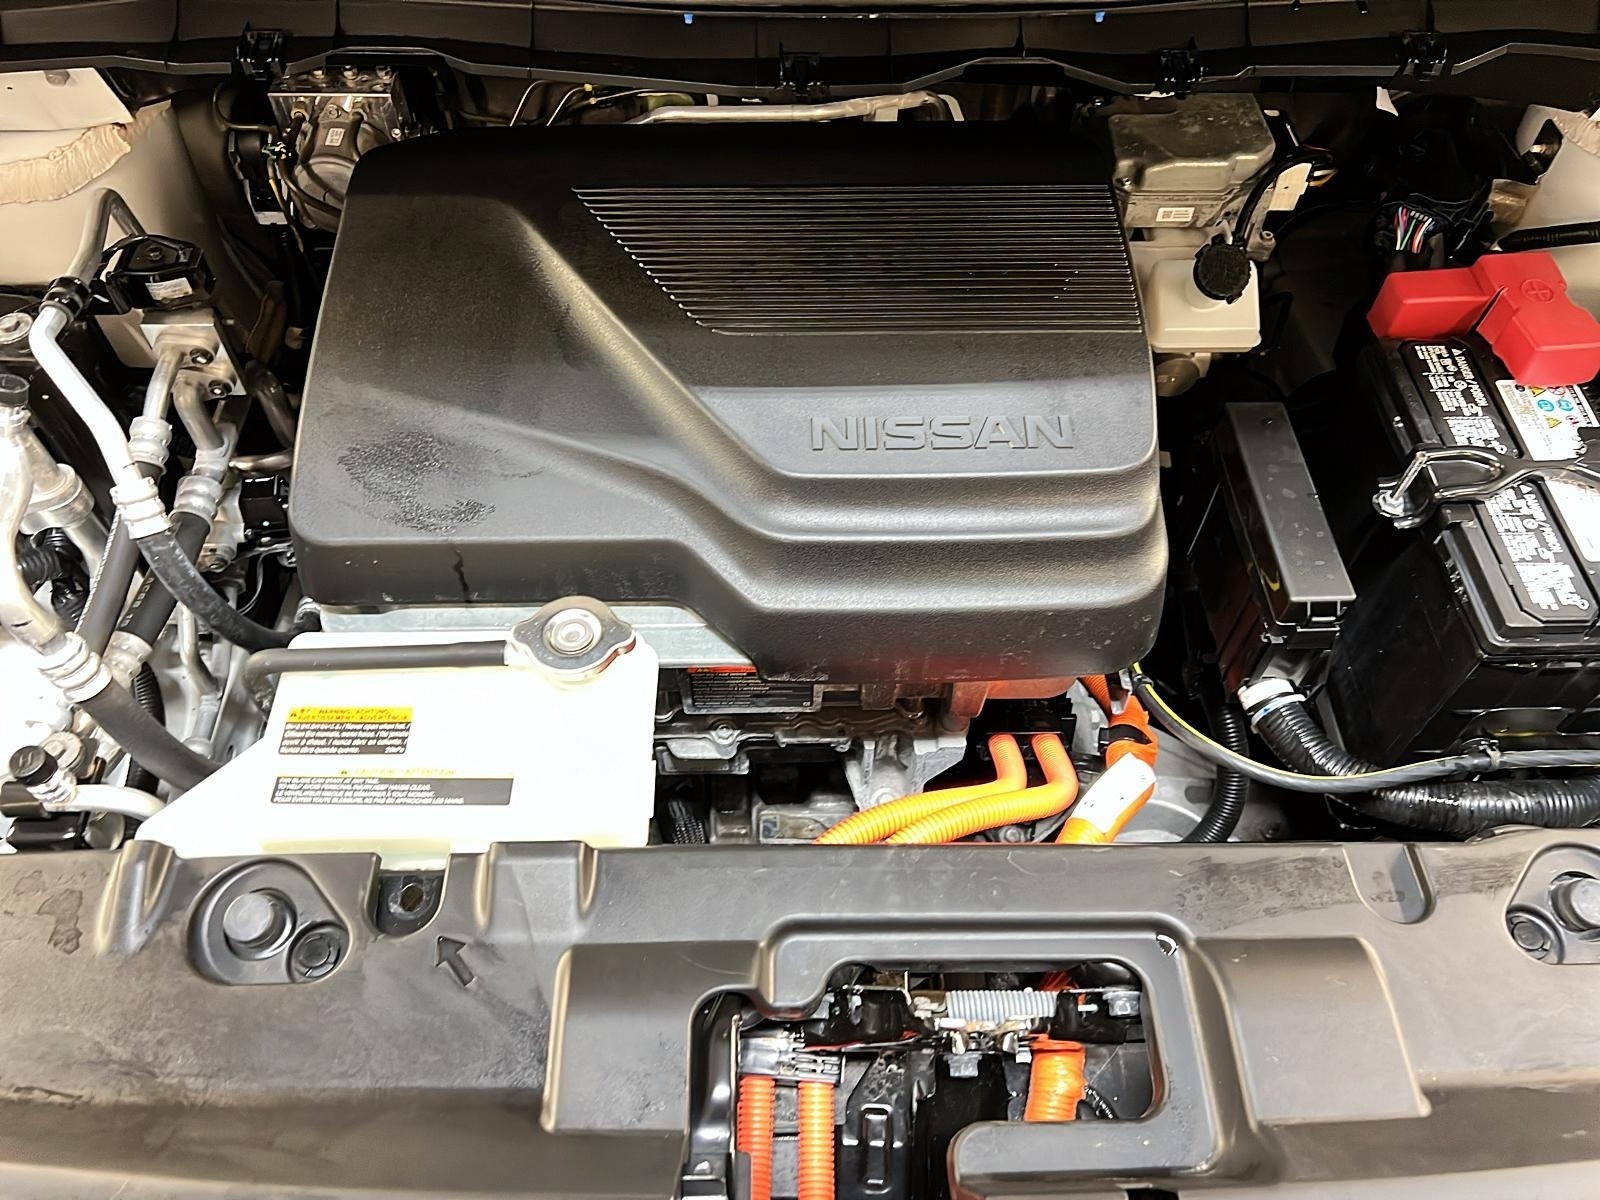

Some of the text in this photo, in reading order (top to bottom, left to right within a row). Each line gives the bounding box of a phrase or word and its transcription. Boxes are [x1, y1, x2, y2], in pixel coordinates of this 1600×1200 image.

[1455, 356, 1474, 379] DANGER
[1468, 385, 1488, 406] POISON
[811, 415, 1074, 451] NISSAN
